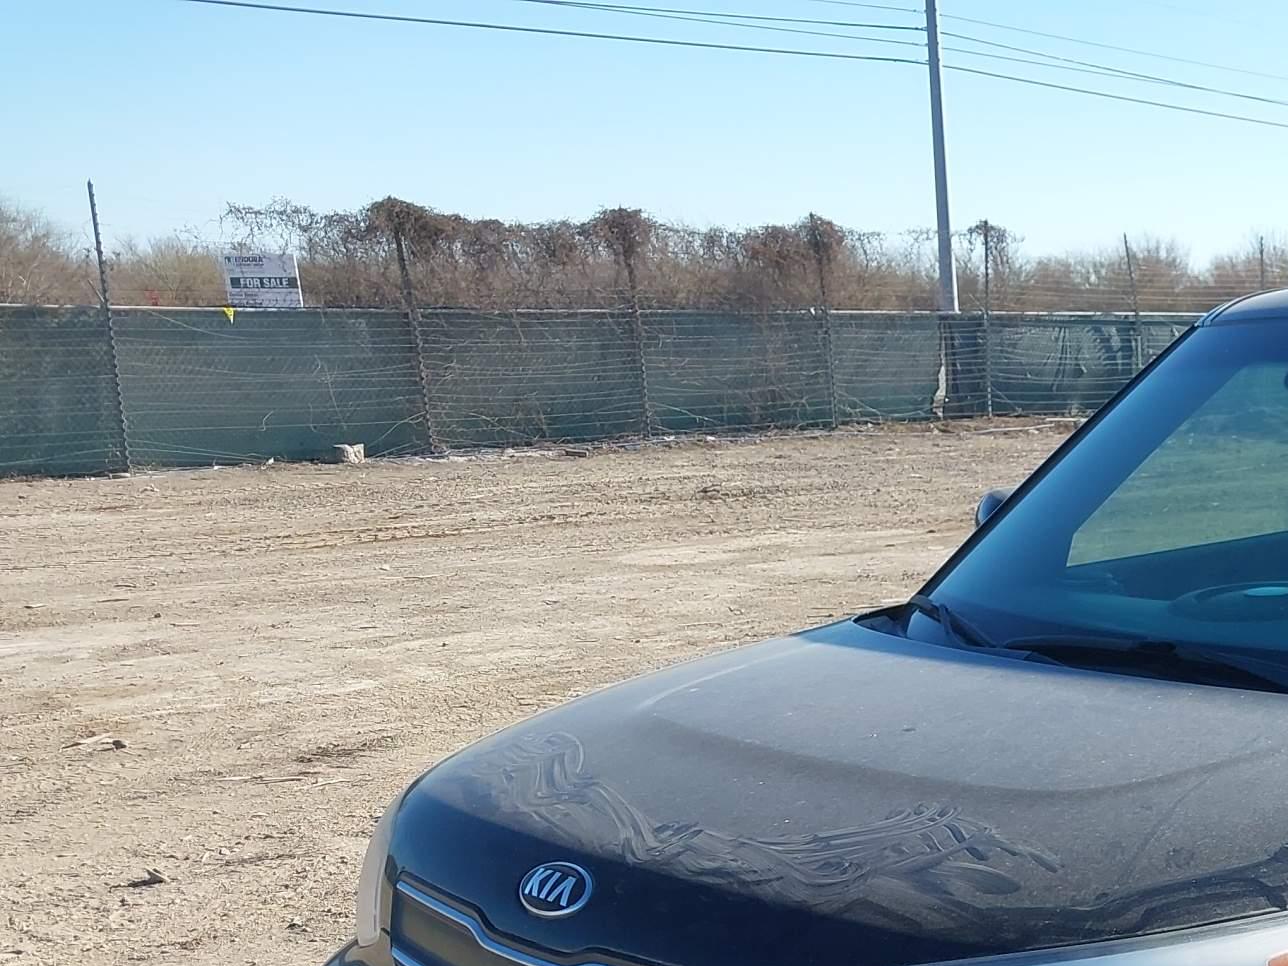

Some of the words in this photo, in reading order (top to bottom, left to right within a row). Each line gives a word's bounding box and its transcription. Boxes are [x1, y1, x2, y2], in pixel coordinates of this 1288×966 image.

[239, 277, 261, 288] FOR
[263, 277, 289, 288] SALE
[523, 866, 577, 907] KIA
